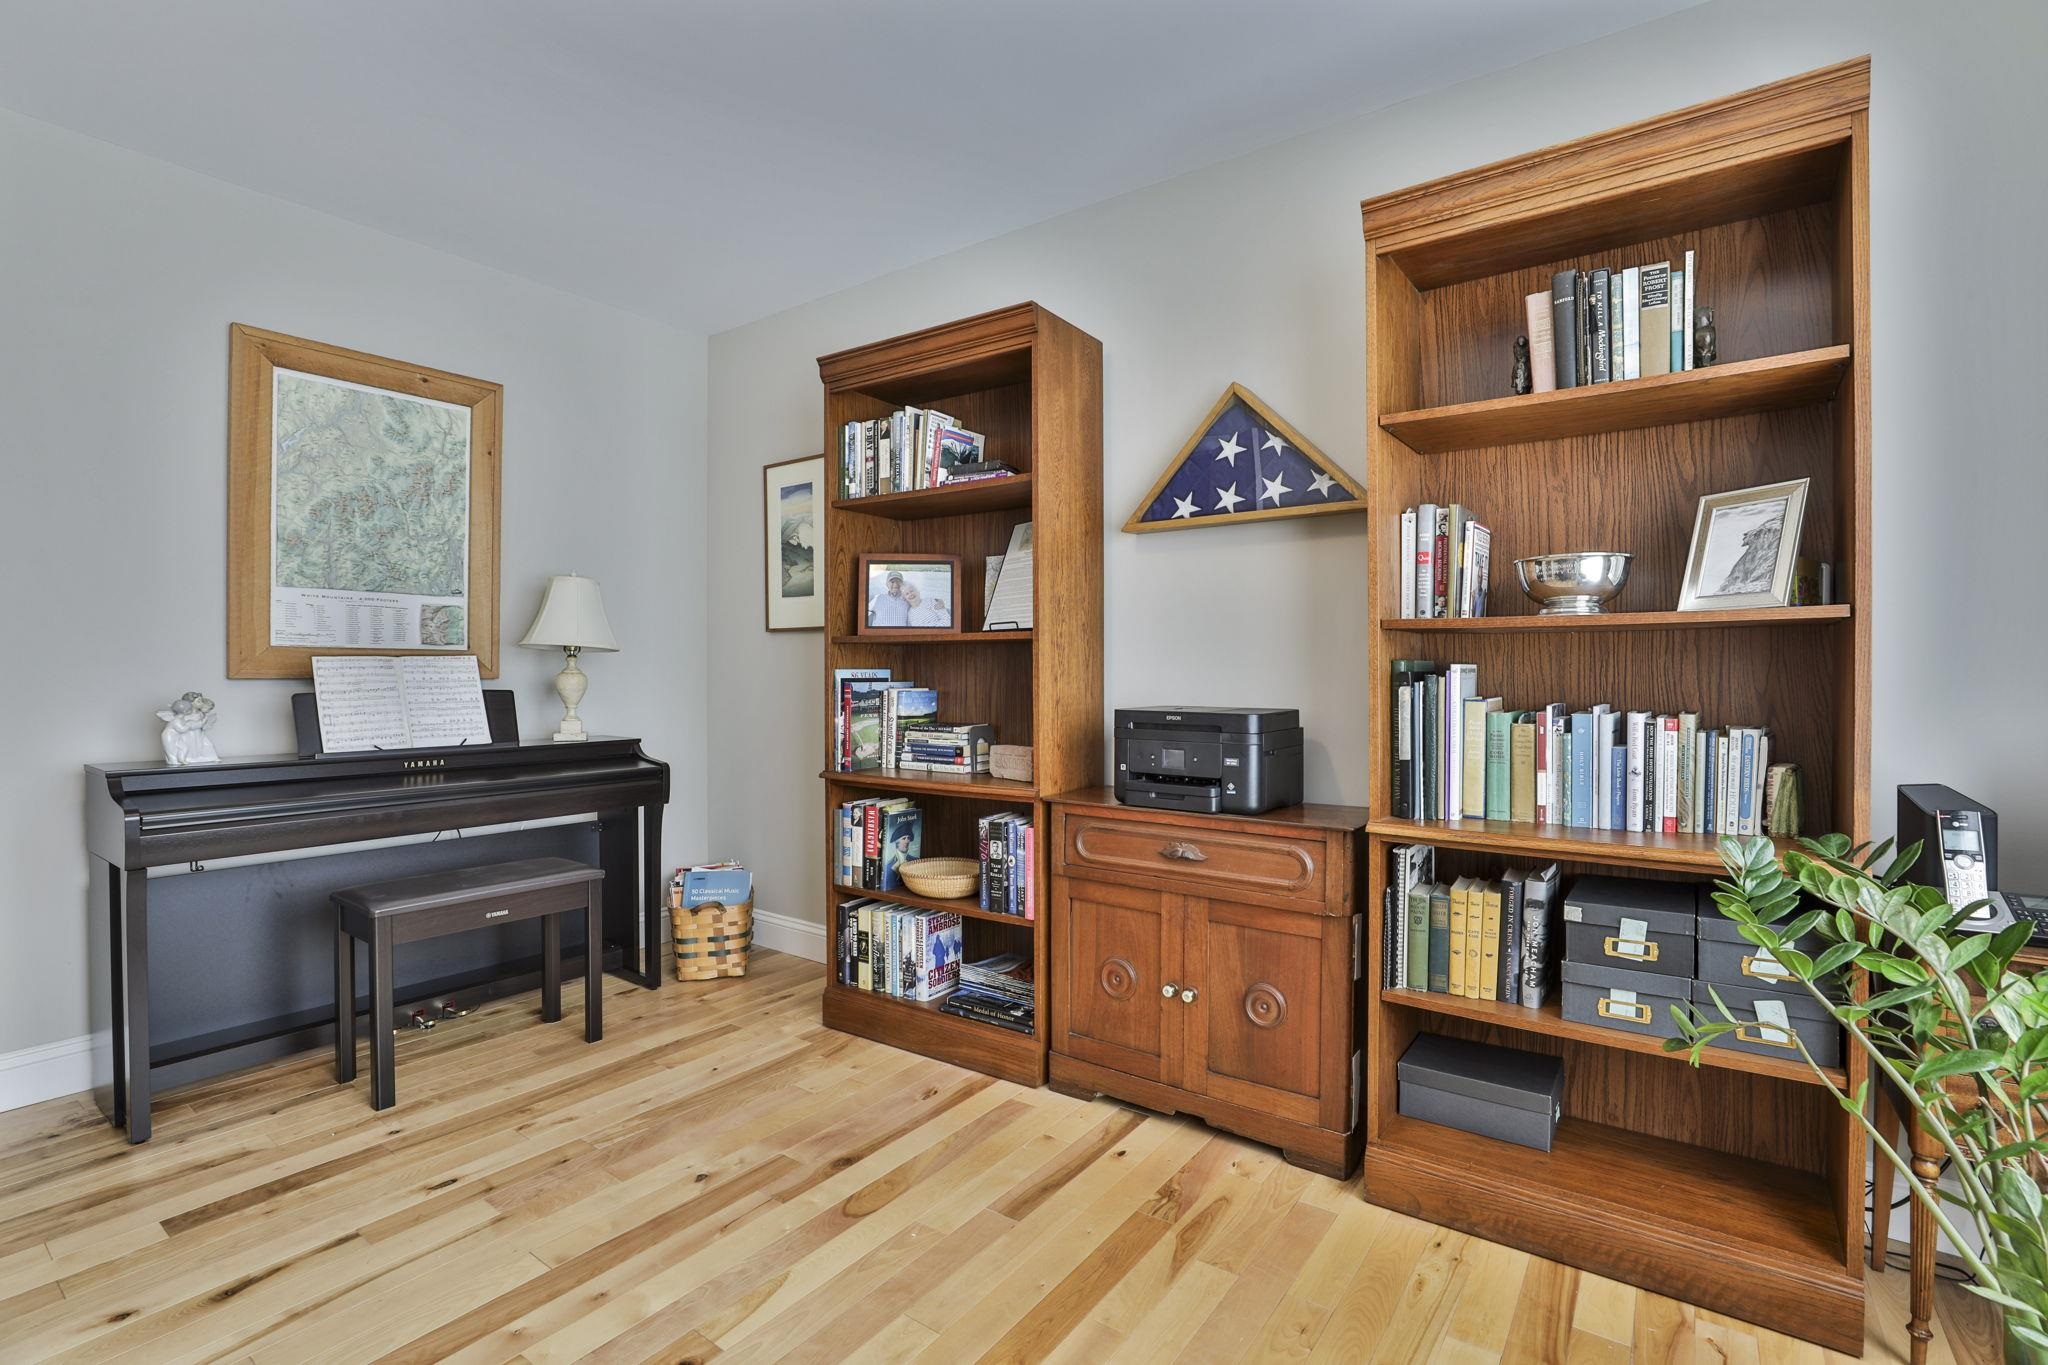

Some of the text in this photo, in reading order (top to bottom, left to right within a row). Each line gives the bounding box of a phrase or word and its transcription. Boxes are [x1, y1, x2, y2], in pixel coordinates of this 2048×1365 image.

[1643, 278, 1667, 286] ROBERT
[1597, 291, 1602, 299] TO
[1595, 329, 1606, 372] Mockingbird
[404, 760, 444, 768] YAMAHA
[897, 816, 906, 824] John
[867, 810, 875, 852] WASHINGTON
[980, 840, 988, 860] 1776
[928, 917, 960, 935] AMBROSE
[1508, 915, 1514, 923] IN
[928, 959, 960, 980] CITIZEN
[1529, 941, 1538, 988] MEACHAM
[973, 1006, 990, 1015] Medal
[997, 1012, 1014, 1021] Honor
